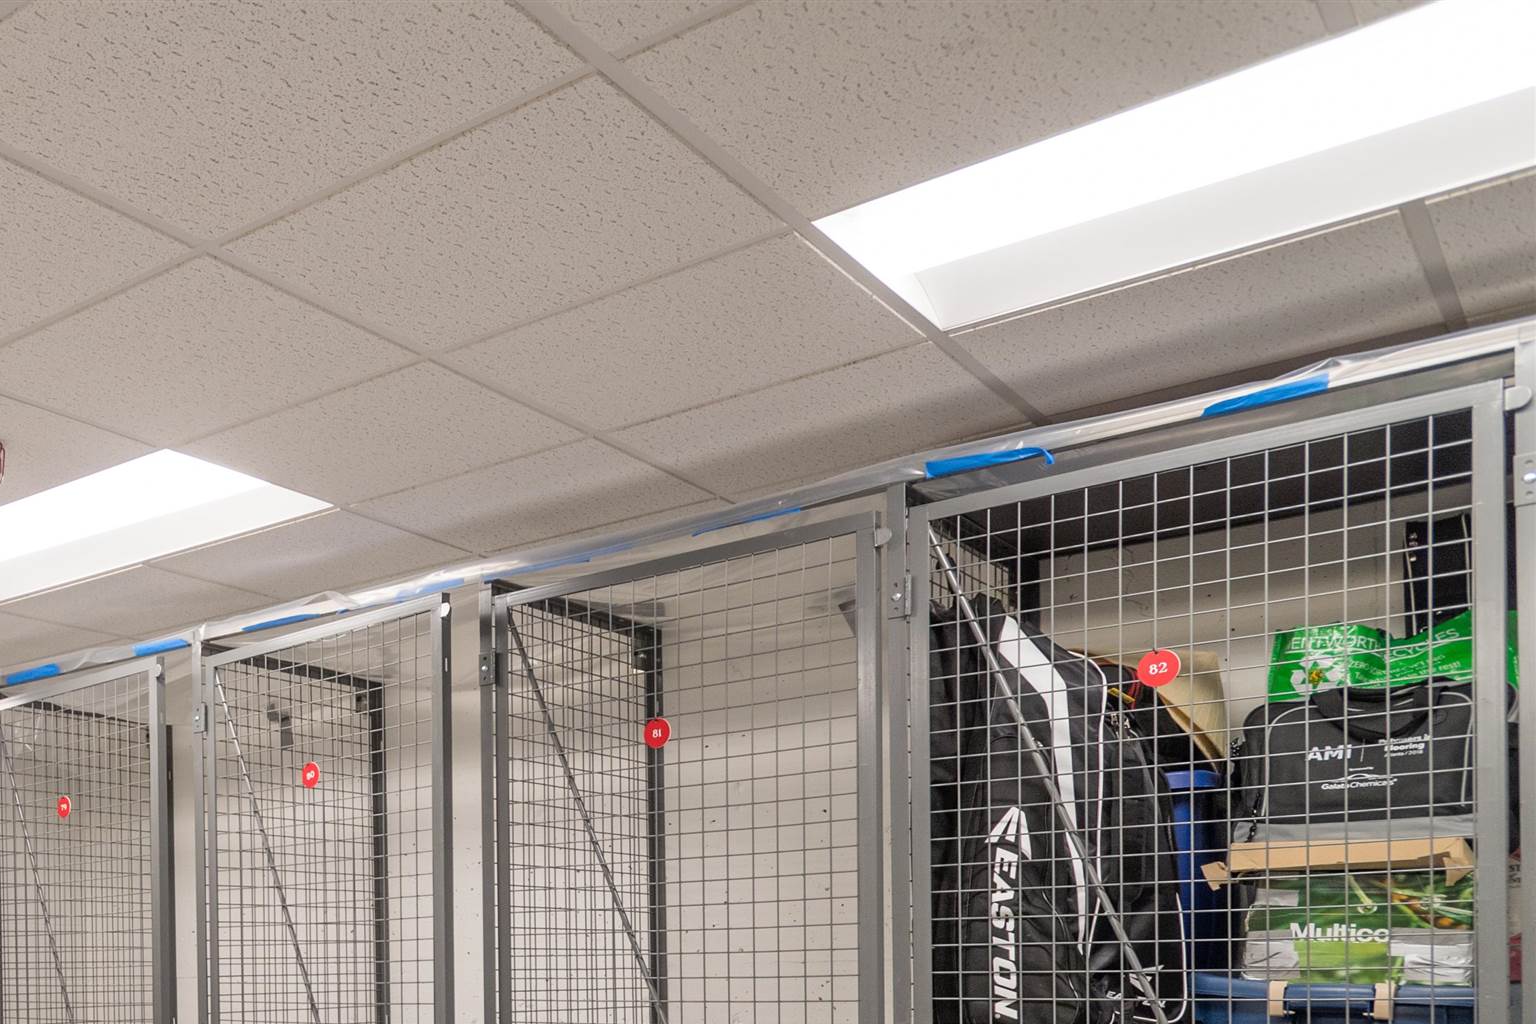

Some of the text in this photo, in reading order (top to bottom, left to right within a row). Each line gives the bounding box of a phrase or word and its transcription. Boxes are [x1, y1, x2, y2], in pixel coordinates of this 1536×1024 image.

[1148, 661, 1168, 675] 82
[652, 728, 662, 738] 81
[1306, 743, 1352, 761] AMI
[991, 846, 1019, 1020] EASTON
